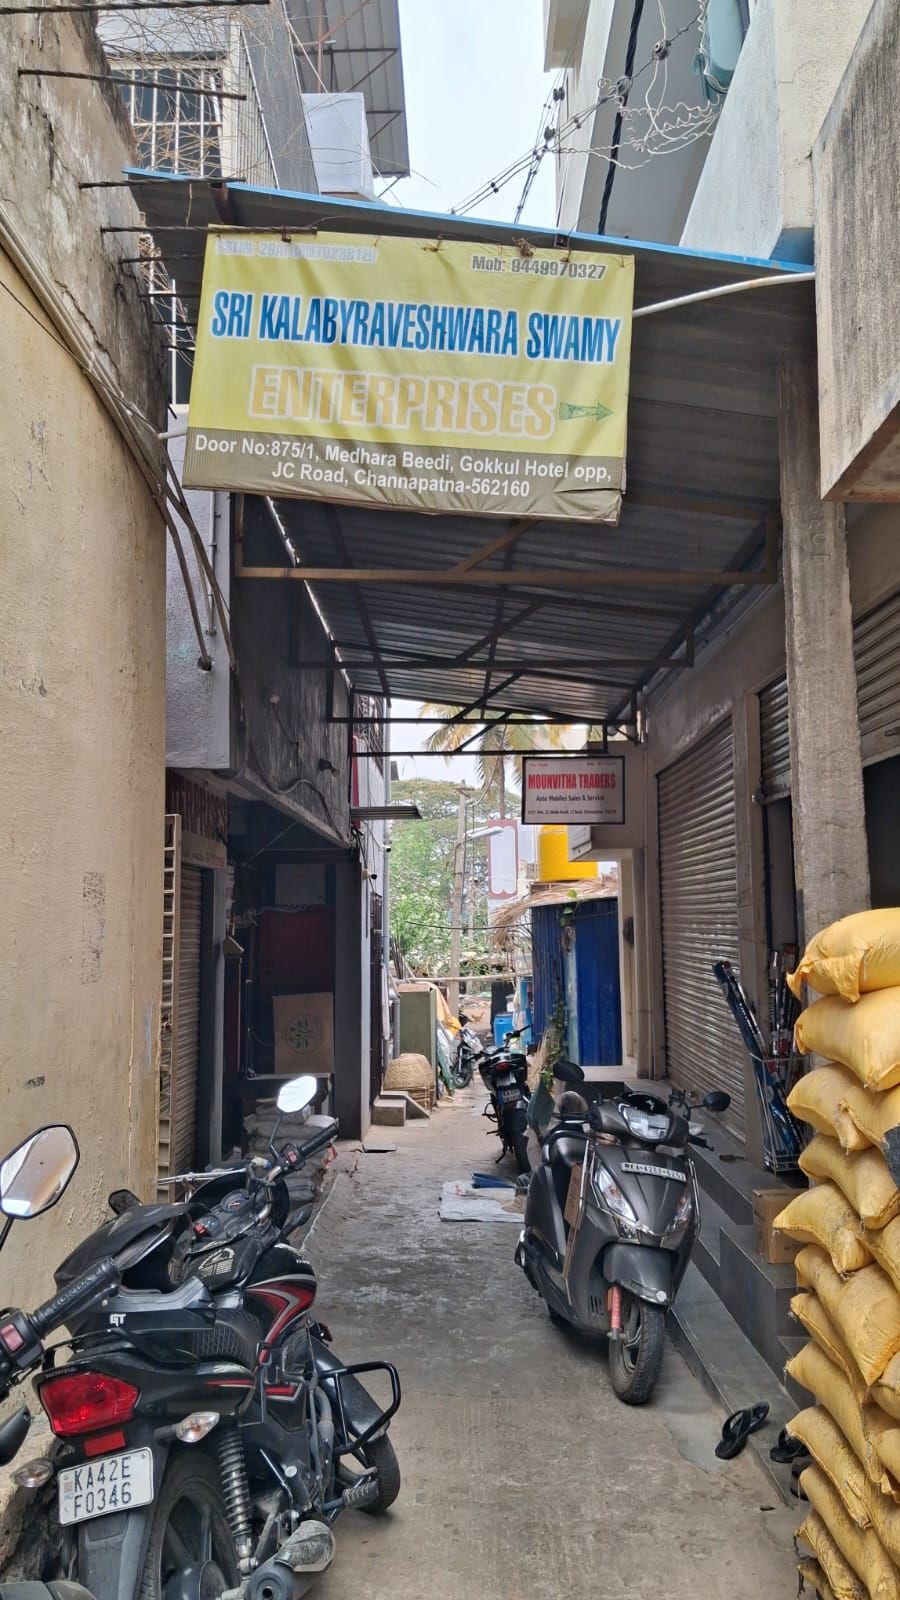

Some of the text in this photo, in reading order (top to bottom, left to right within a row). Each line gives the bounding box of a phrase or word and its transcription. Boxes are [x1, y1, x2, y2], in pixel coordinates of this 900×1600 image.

[472, 256, 606, 279] Mob: 9449970327
[211, 291, 621, 362] SRI KALABYRAVESHWARA SWAMY
[249, 366, 556, 438] ENTERPRISES
[195, 434, 611, 482] Door No:875/1, Medhara Beedi, Gokkul Hotel opp,
[272, 462, 530, 497] JC Road, Channapatna-562160
[528, 772, 616, 789] MOUNVITHA TRADERS
[74, 1456, 131, 1493] KA42E
[74, 1482, 132, 1517] F0346
